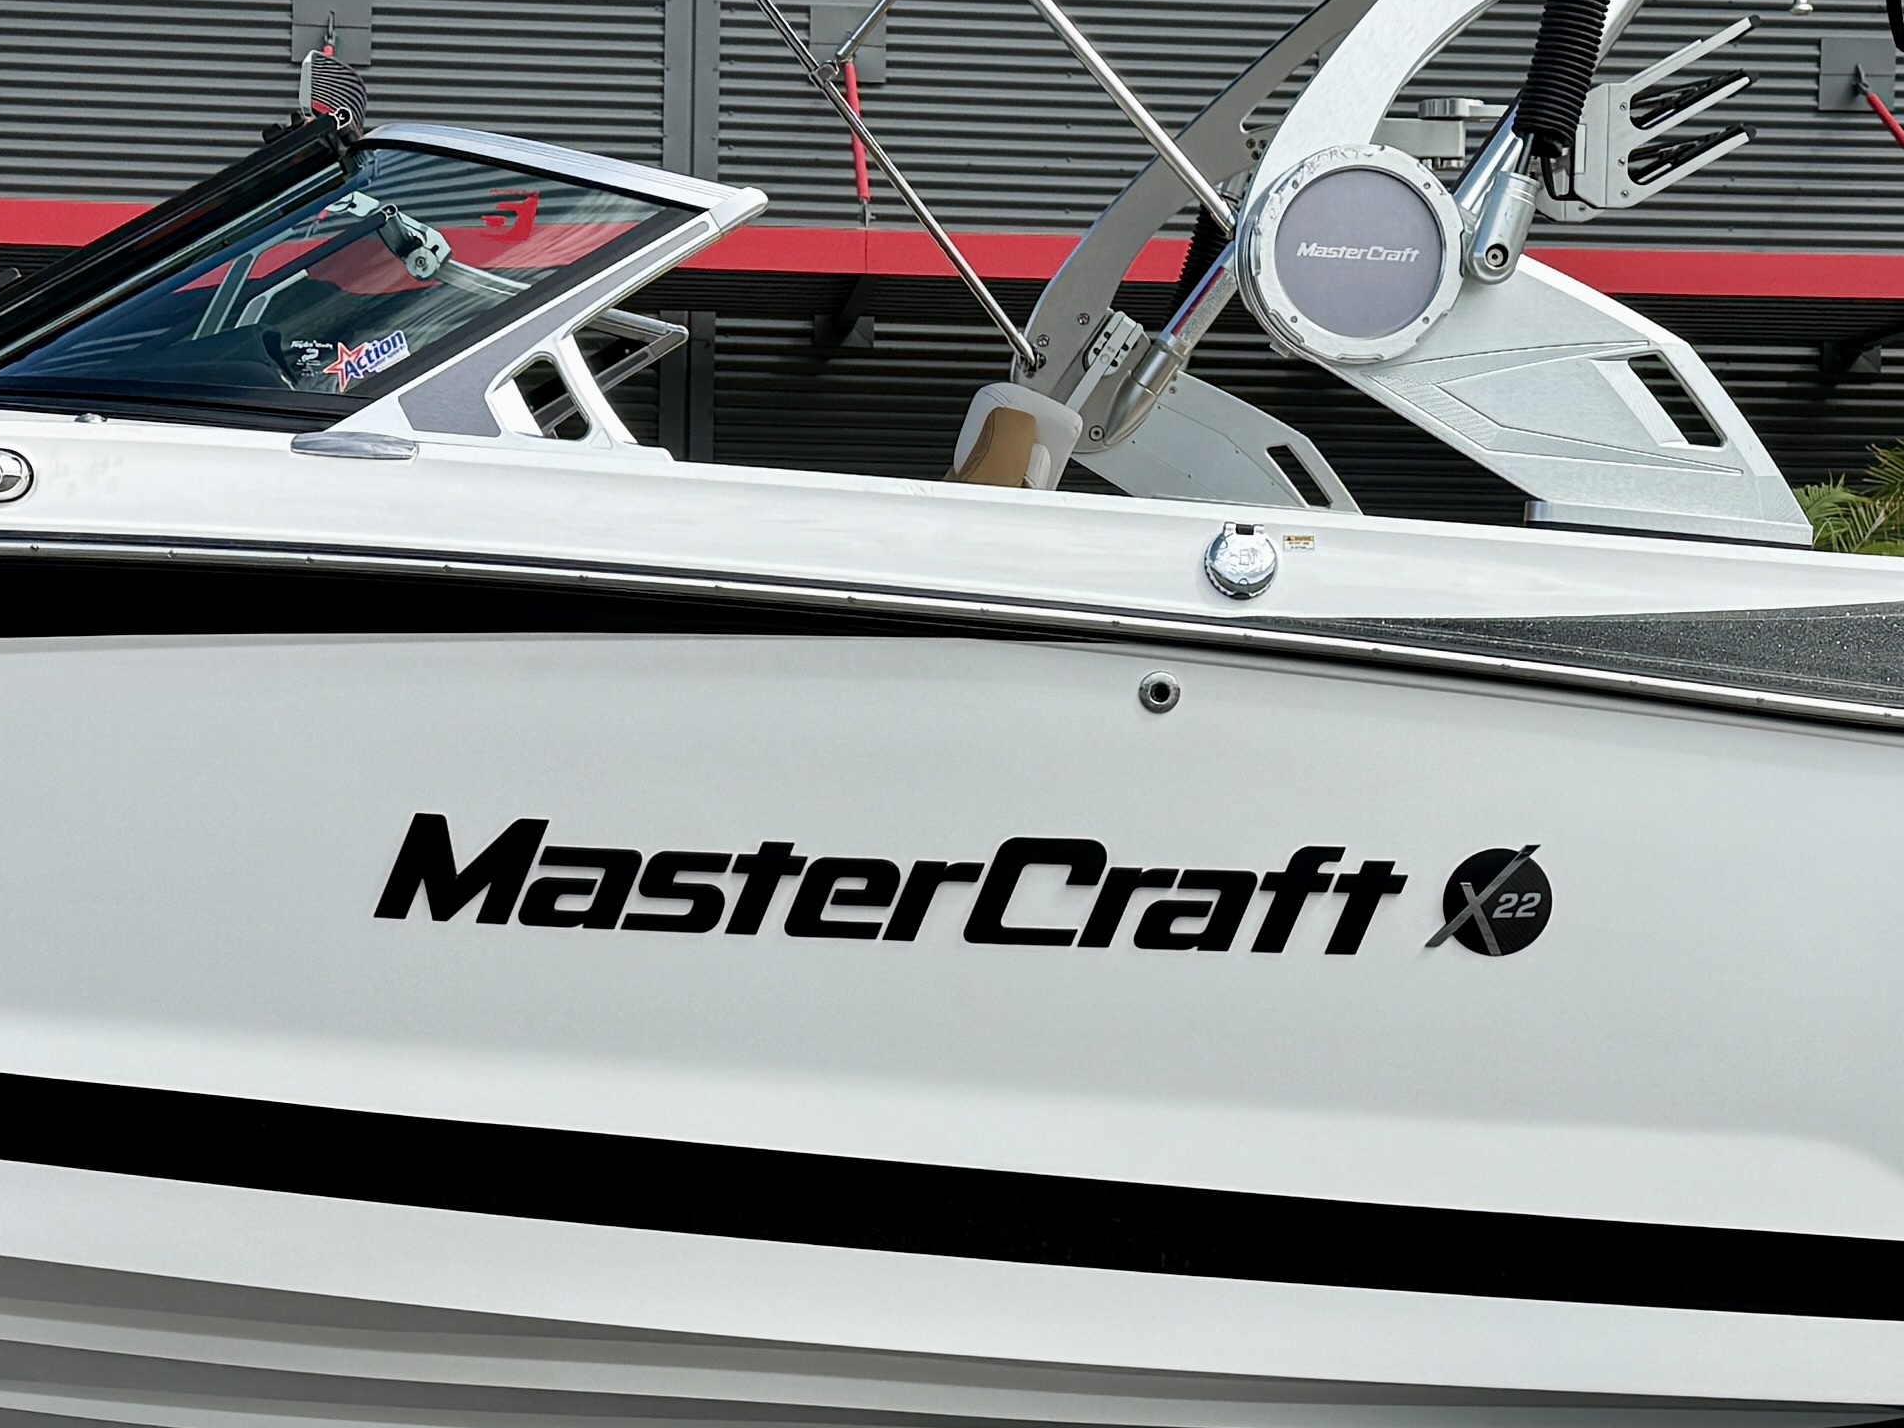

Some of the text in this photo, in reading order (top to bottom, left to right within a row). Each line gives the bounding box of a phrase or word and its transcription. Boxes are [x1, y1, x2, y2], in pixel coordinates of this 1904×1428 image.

[1296, 241, 1420, 262] MasterCraft
[344, 331, 405, 380] Action
[373, 812, 1542, 957] MasterCraft X22
